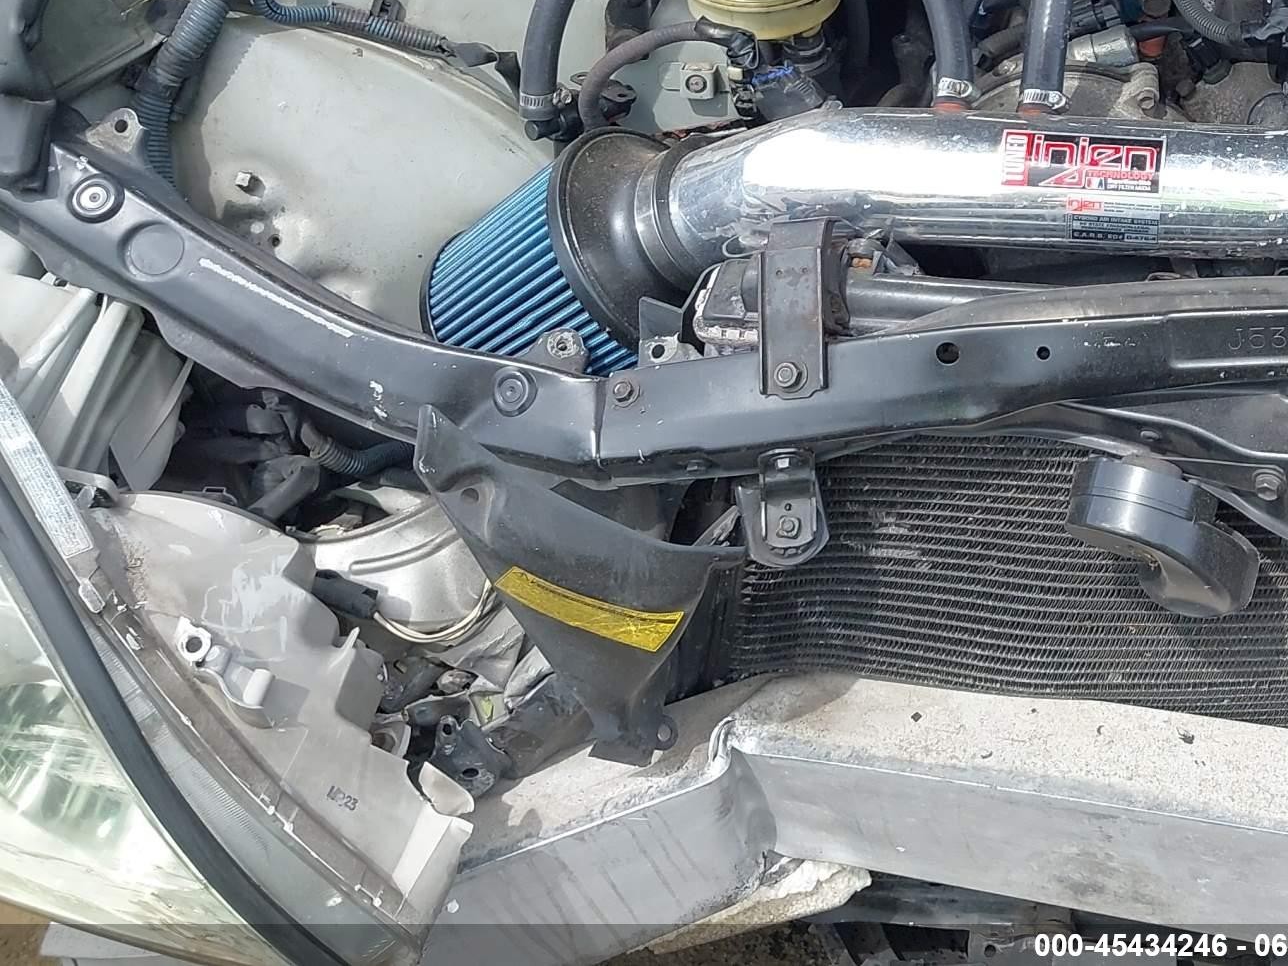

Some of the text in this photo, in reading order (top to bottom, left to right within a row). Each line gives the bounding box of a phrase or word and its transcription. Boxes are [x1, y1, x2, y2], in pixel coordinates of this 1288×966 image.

[1002, 134, 1027, 181] TUNED
[1032, 134, 1157, 188] injen
[1086, 169, 1154, 181] TECHNOLOGY
